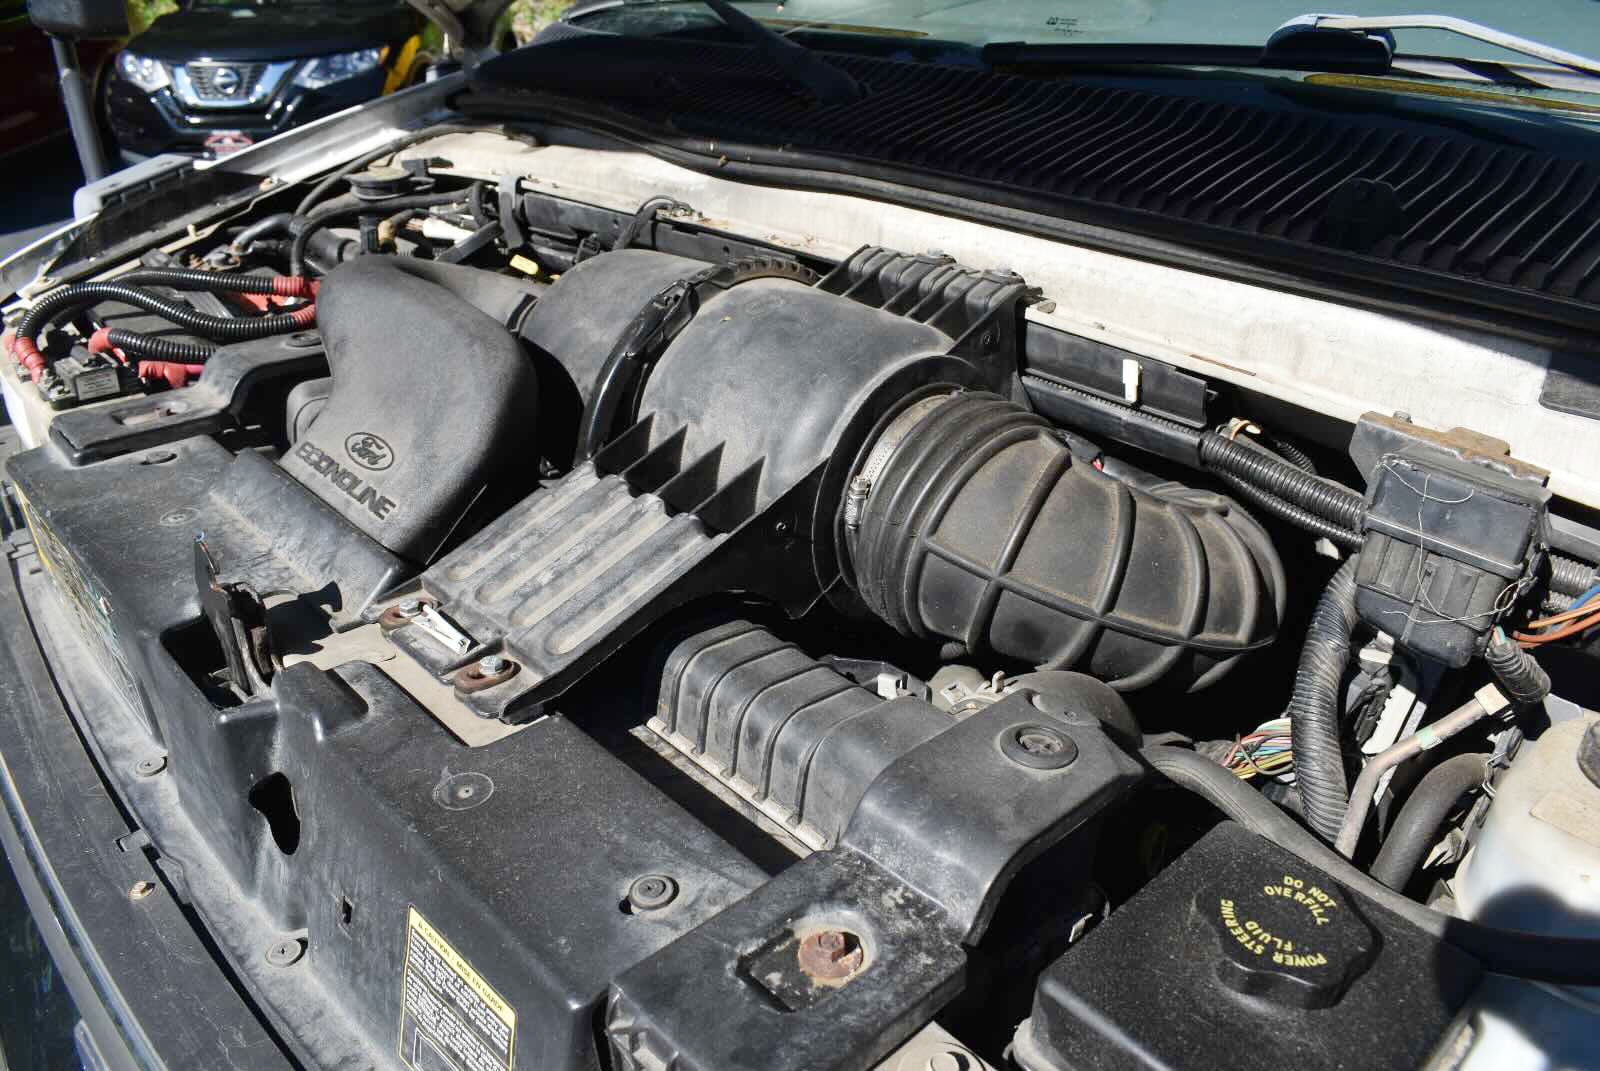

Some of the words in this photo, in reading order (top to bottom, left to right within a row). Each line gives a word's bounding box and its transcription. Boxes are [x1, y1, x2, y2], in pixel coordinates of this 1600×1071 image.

[295, 441, 397, 520] ECONOLINE
[1264, 886, 1330, 925] OVERFILL
[1283, 875, 1303, 888] DO
[1308, 886, 1337, 908] NOT
[425, 929, 450, 957] CAUTION
[1220, 898, 1264, 955] STEERING
[1245, 920, 1293, 952] FLUID
[1273, 952, 1328, 967] POWER
